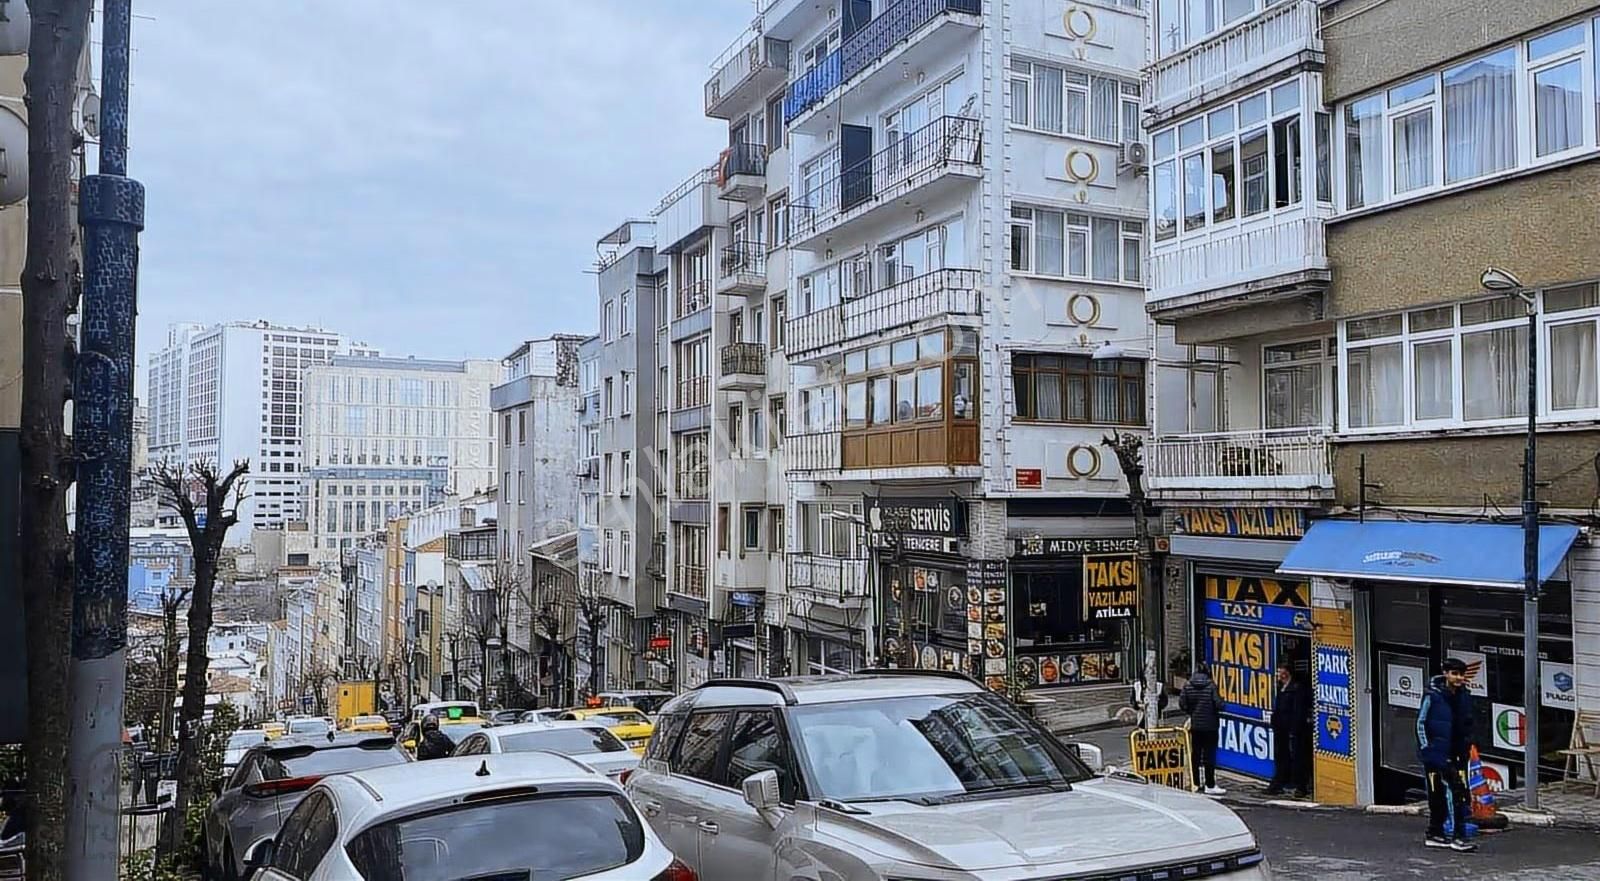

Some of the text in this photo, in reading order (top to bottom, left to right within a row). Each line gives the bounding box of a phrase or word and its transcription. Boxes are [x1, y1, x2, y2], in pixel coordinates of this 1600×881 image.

[910, 502, 951, 532] SERVİS
[1231, 508, 1299, 536] YAZILARI
[1088, 590, 1136, 607] YAZILARI
[1095, 605, 1131, 619] ATİLLA
[1220, 602, 1263, 619] TAXI
[1318, 653, 1349, 675] PARK
[1211, 664, 1272, 710] YAZILARI
